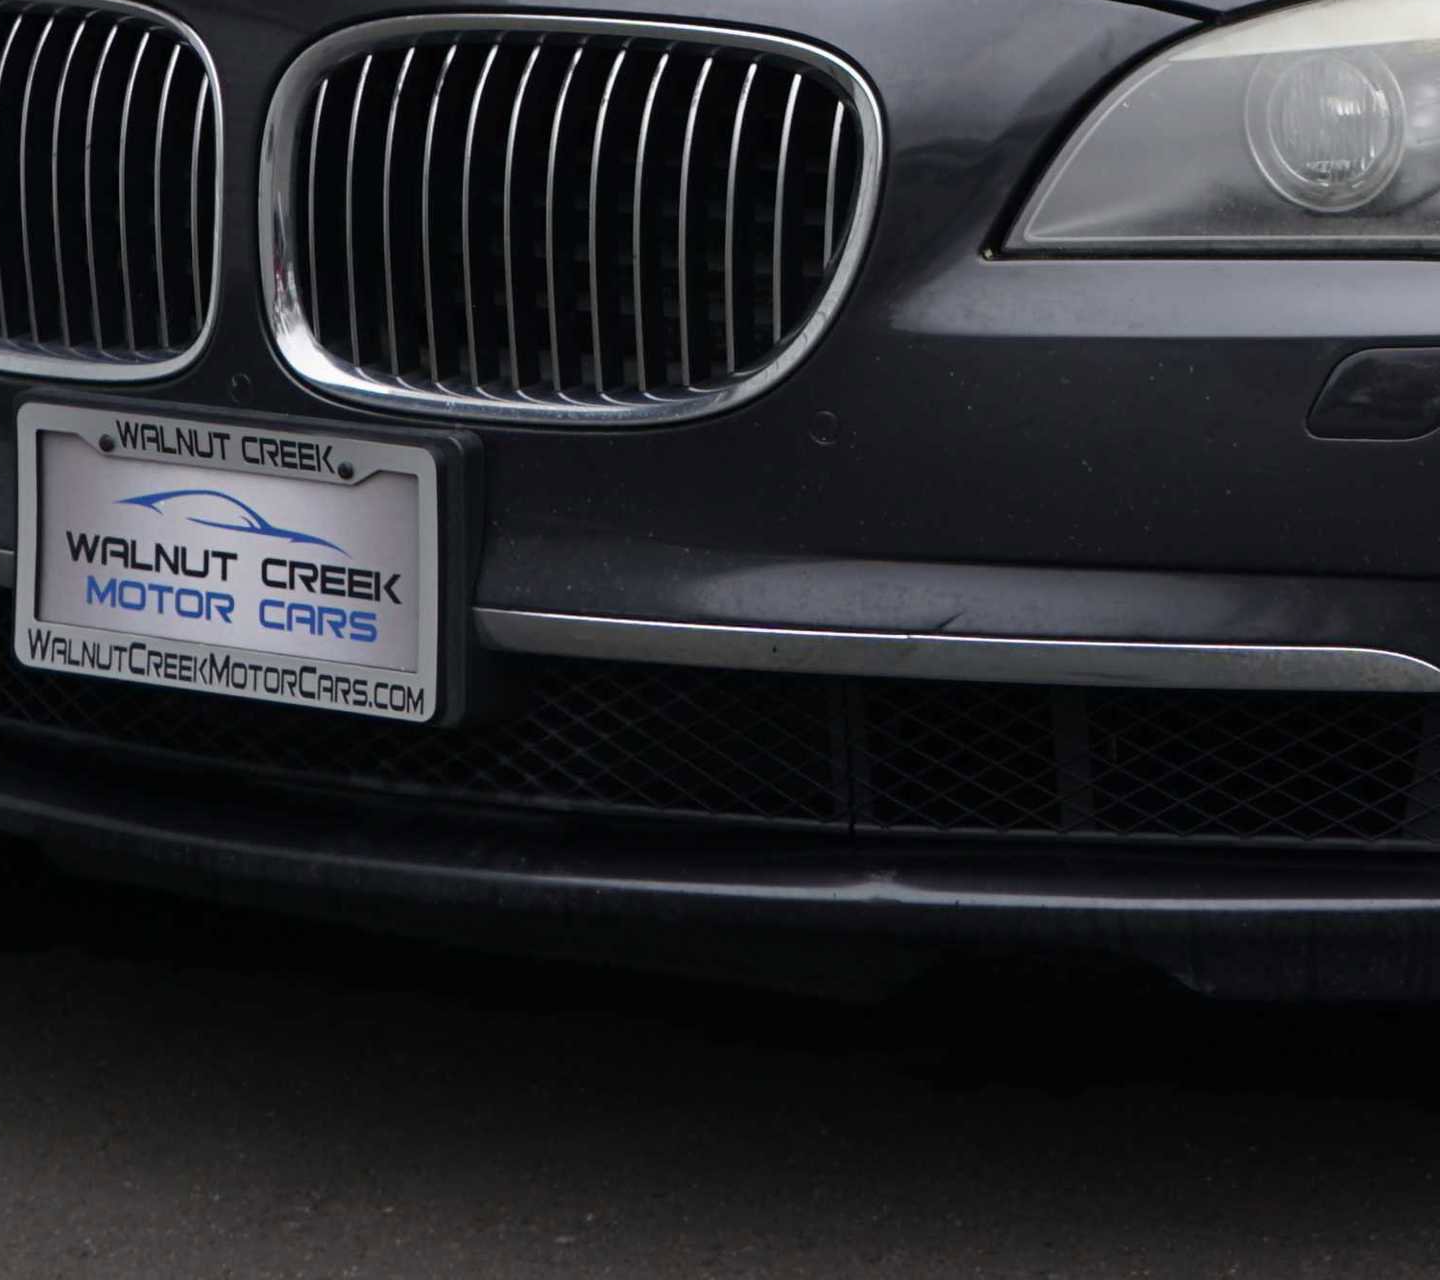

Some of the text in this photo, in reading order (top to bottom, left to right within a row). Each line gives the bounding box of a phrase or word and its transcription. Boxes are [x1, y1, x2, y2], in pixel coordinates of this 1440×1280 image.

[115, 419, 336, 475] WALNUT CREEK
[66, 530, 403, 605] WALNUT CREEK
[85, 575, 378, 642] MOTOR CARS
